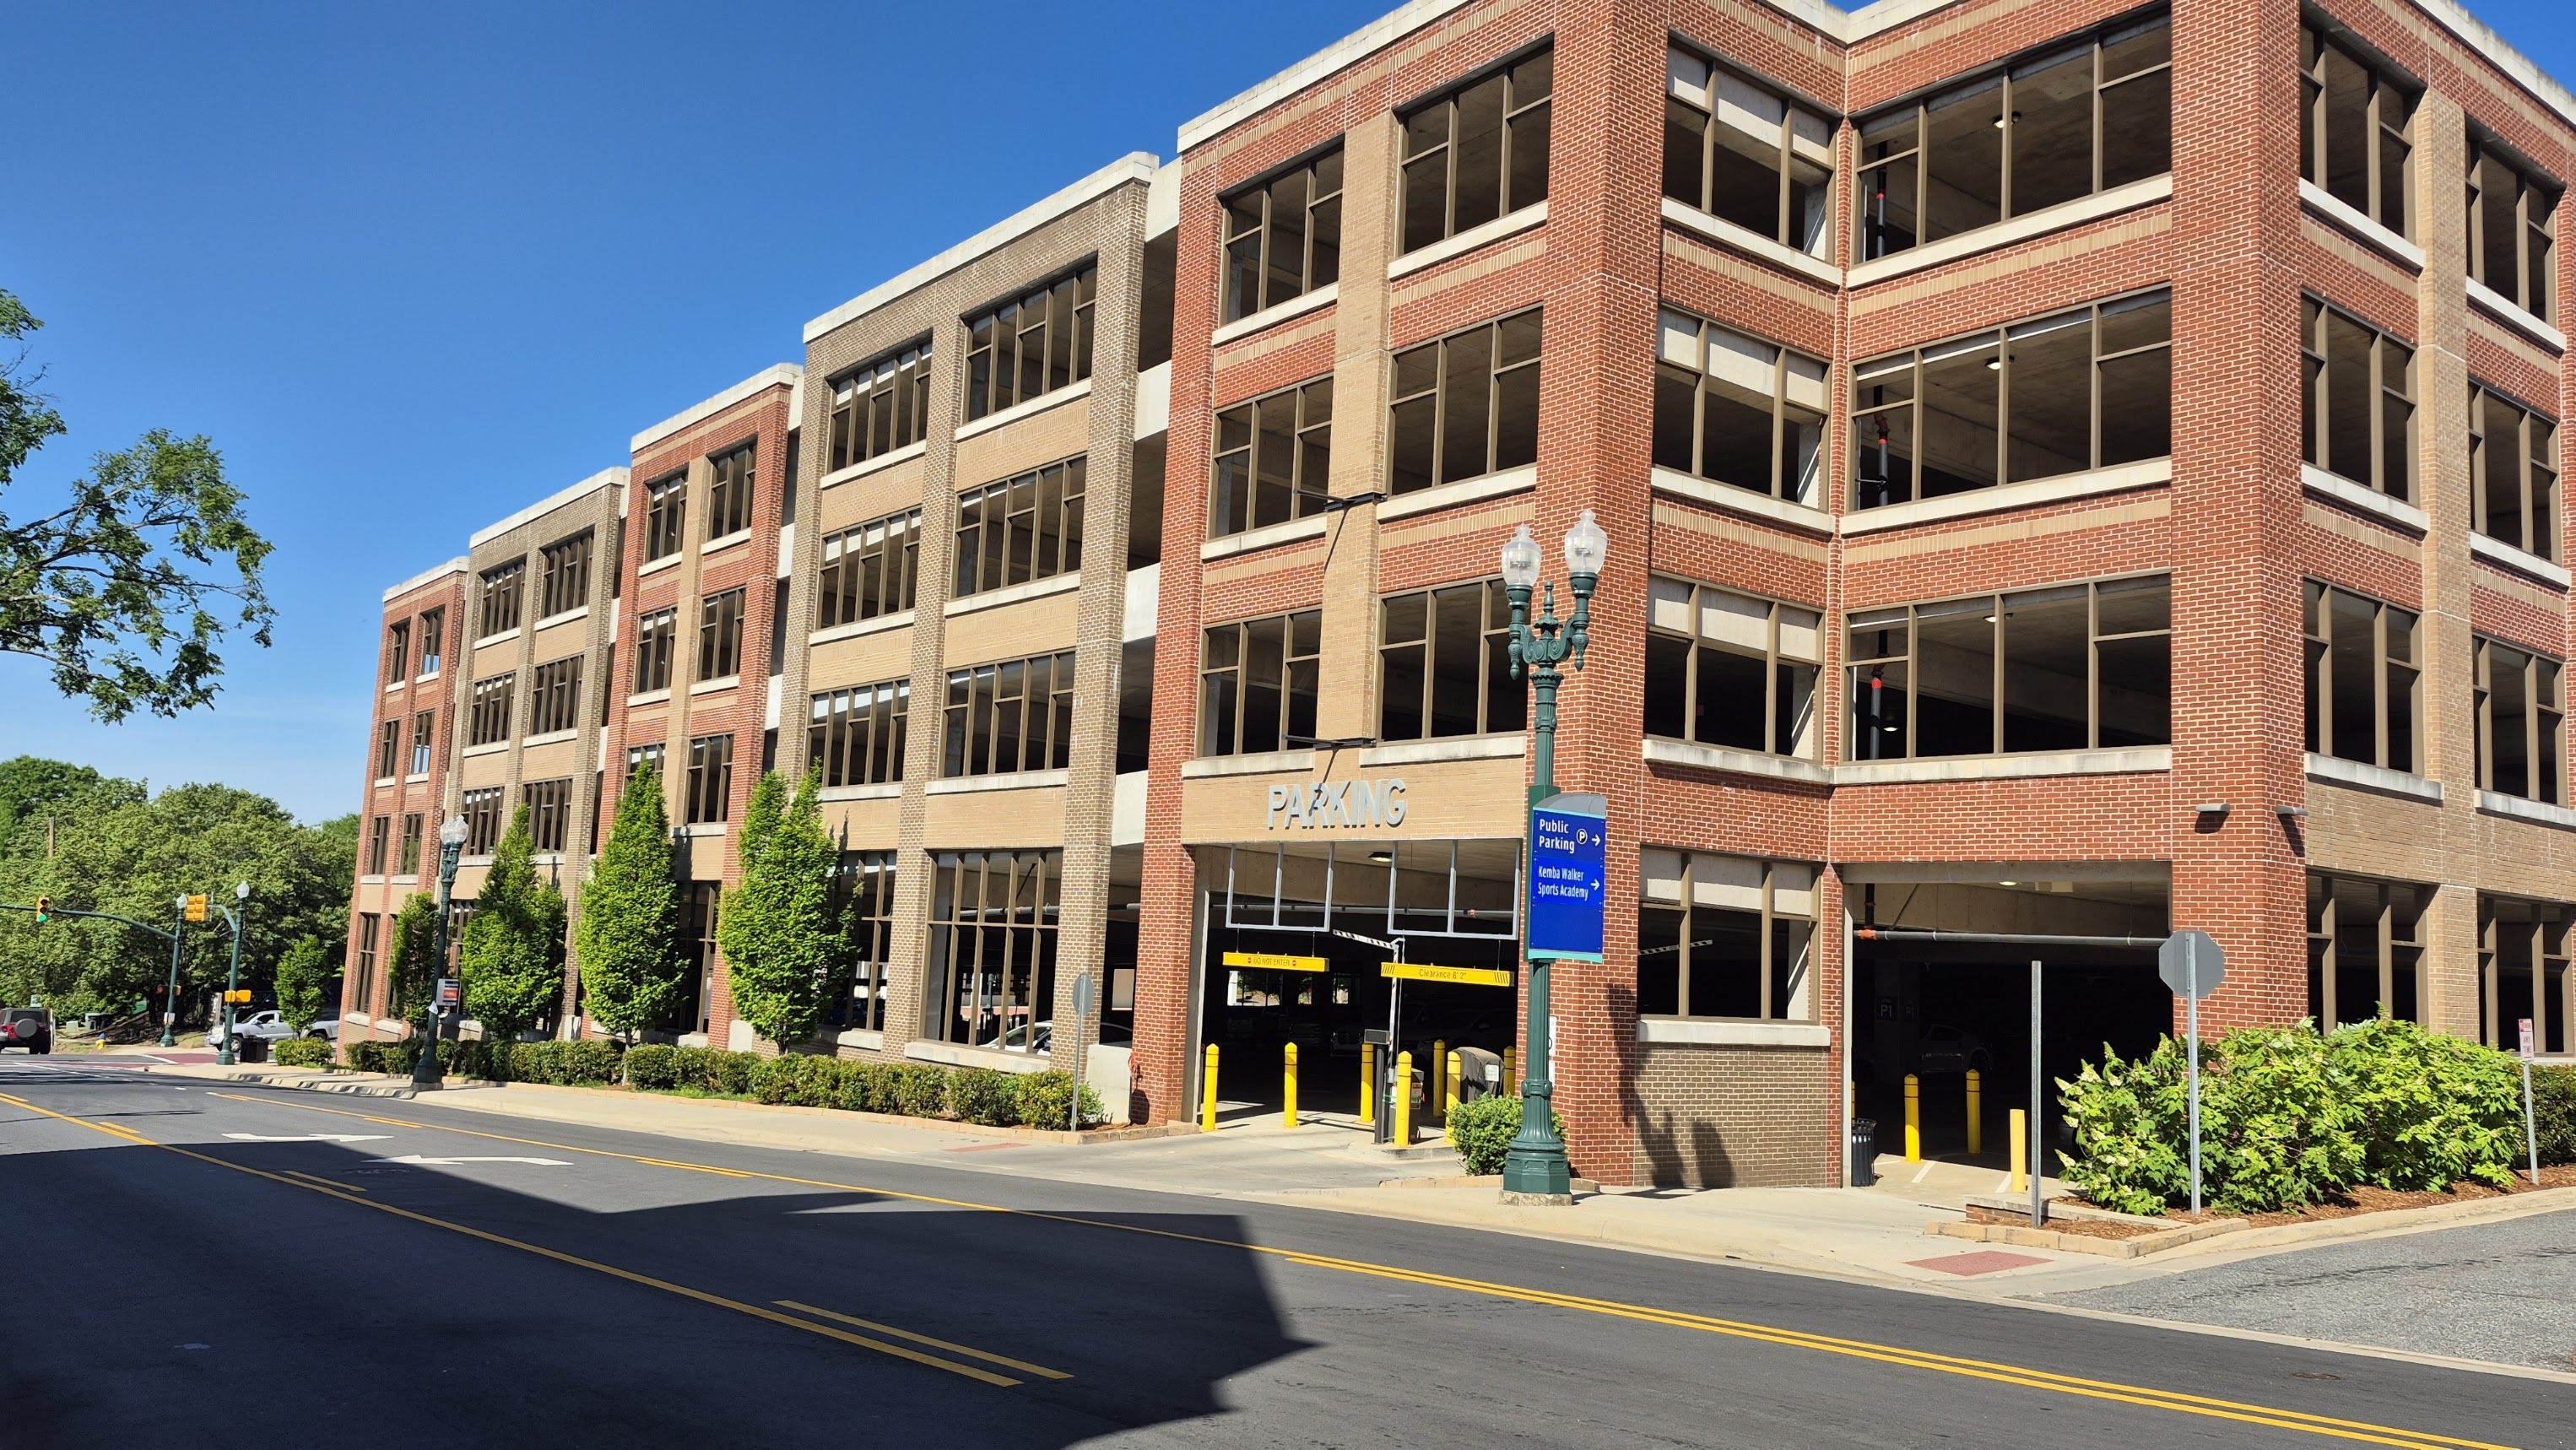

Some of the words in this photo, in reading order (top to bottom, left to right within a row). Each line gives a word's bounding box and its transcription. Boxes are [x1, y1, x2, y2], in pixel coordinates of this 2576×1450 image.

[1268, 778, 1407, 831] PARKING
[1540, 819, 1569, 834] Public
[1539, 836, 1575, 854] Parking
[1538, 866, 1561, 879] Kemba
[1561, 868, 1584, 881] Walker
[1538, 883, 1559, 897] Sports
[1560, 885, 1588, 901] Academy
[1419, 968, 1451, 979] Clearance
